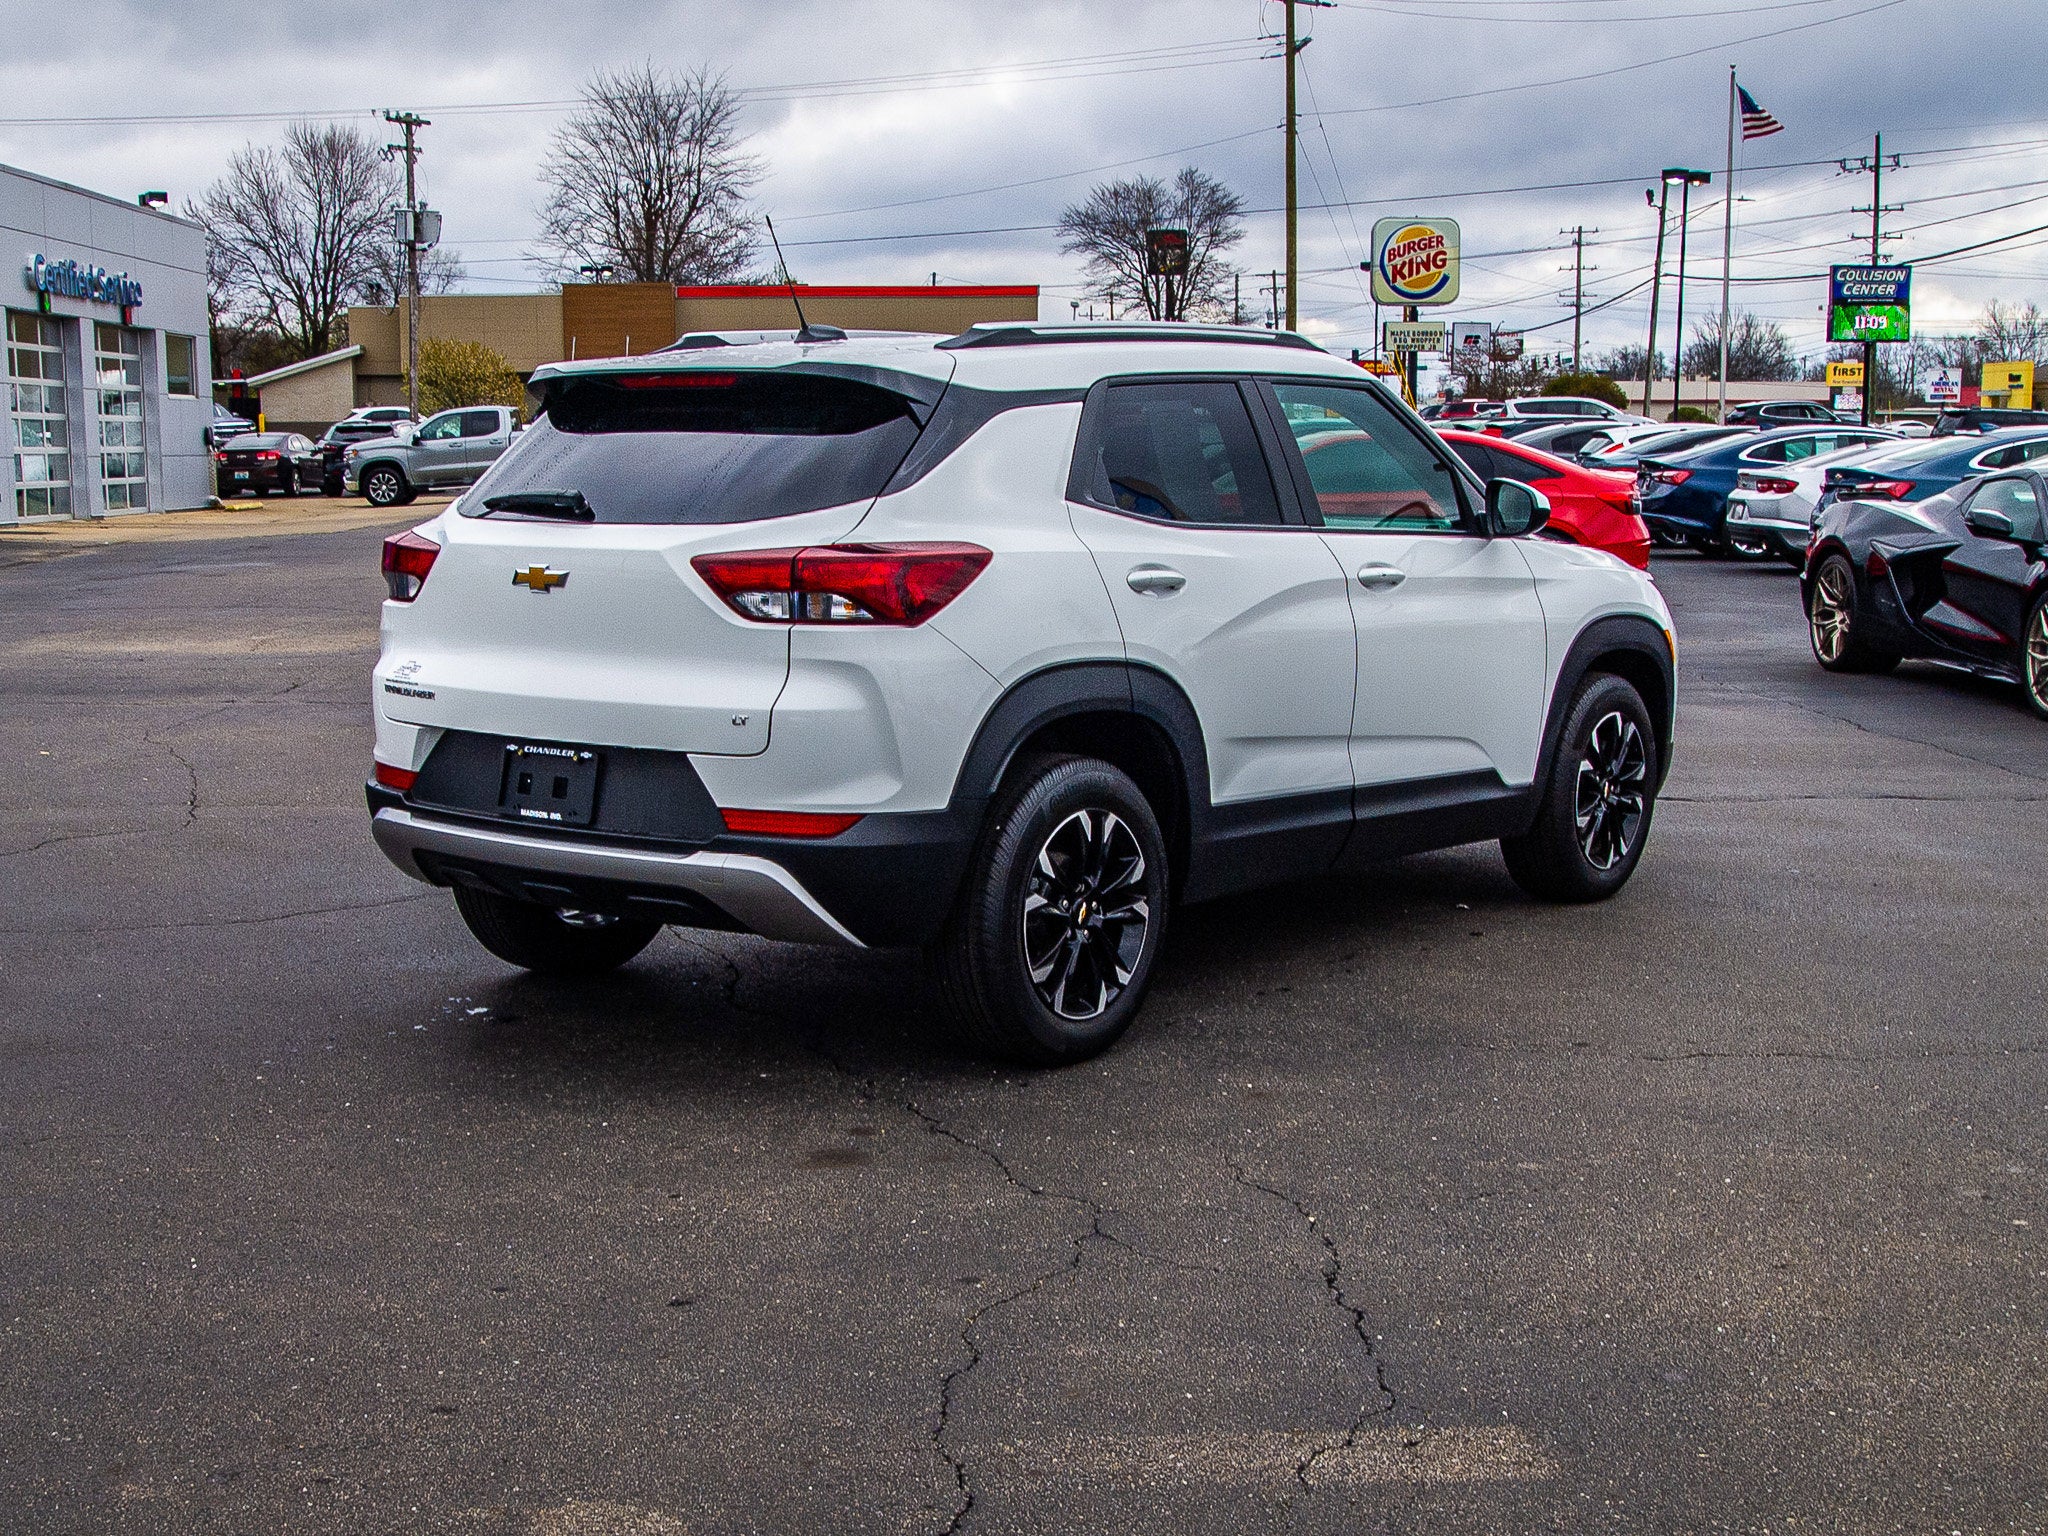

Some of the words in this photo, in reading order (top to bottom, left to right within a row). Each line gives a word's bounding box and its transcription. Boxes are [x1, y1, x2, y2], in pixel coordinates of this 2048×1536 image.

[1387, 235, 1445, 263] BURGER
[1391, 250, 1448, 284] KING
[35, 253, 94, 300] Certified
[97, 267, 143, 307] Service
[1836, 269, 1907, 282] COLLISION
[1843, 284, 1896, 295] CENTER
[1854, 315, 1889, 329] 11:09
[731, 714, 749, 726] LT
[524, 745, 575, 757] CHANDLER
